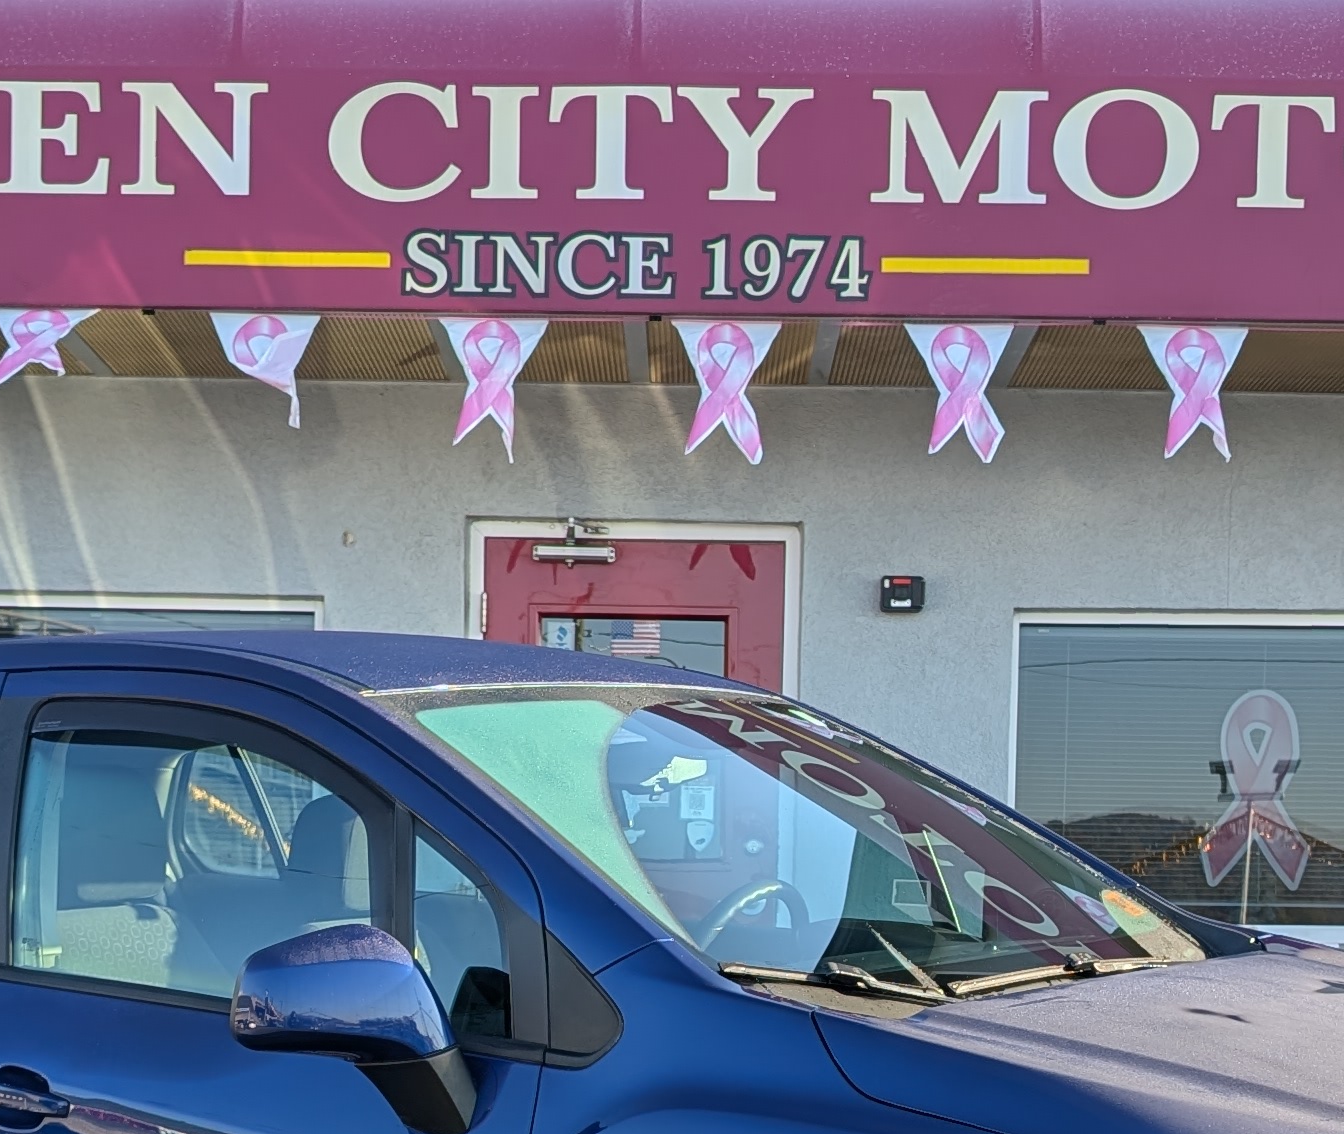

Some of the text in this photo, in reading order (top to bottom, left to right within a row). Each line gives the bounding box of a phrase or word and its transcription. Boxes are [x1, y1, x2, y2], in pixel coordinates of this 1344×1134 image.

[328, 82, 814, 202] CITY
[402, 229, 869, 302] SINCE 1974
